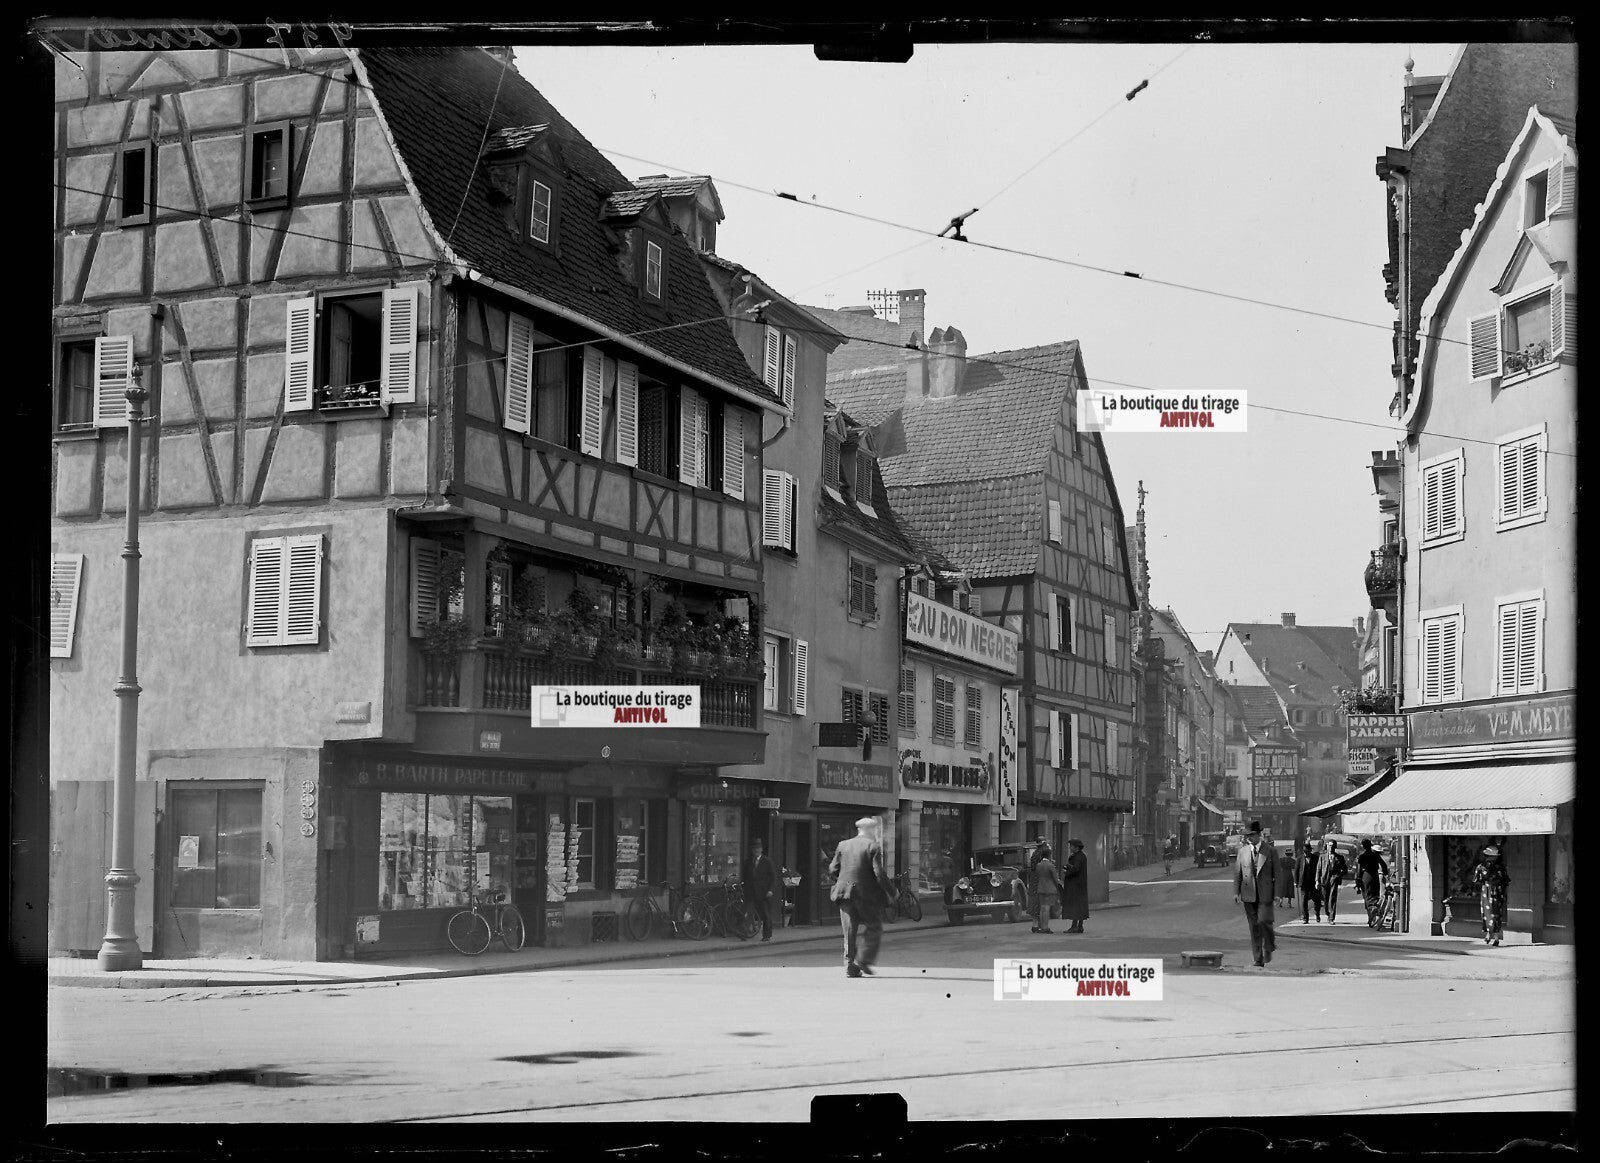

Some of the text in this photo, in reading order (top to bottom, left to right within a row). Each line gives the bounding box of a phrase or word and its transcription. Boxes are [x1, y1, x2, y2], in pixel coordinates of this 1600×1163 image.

[918, 603, 936, 638] AU
[940, 611, 968, 651] BON
[1350, 716, 1405, 727] NAPPES
[1350, 727, 1405, 738] D'ALSACE
[1349, 752, 1374, 761] FISCHER
[395, 764, 448, 784] BARTH
[456, 768, 527, 786] PAPETERIE
[1390, 813, 1489, 831] LAINES DU PINGOUIN
